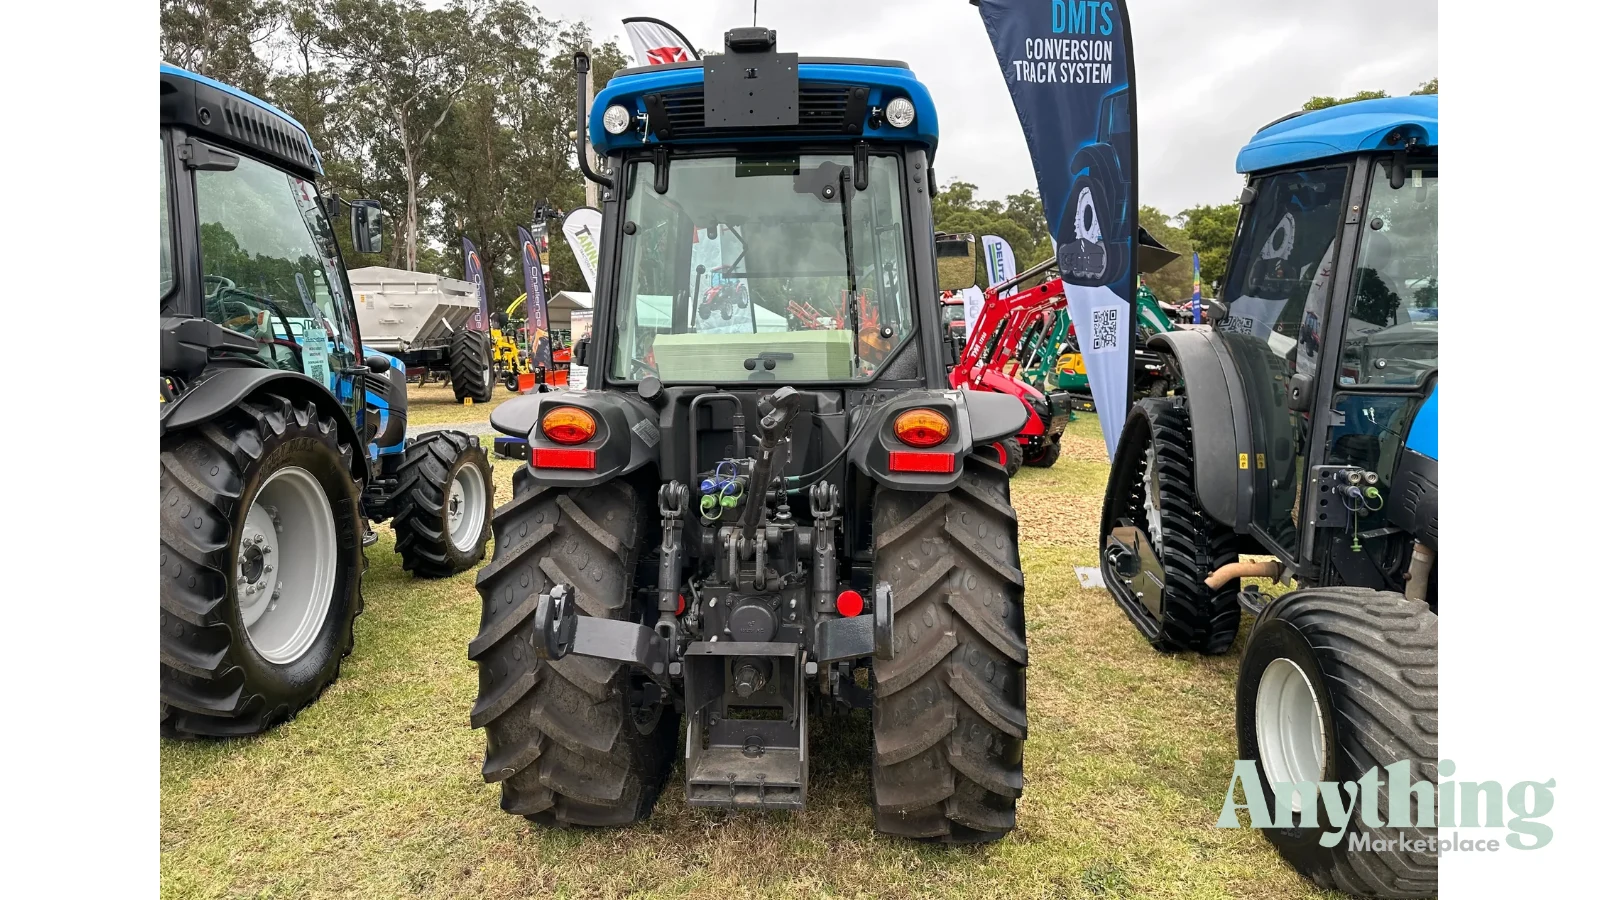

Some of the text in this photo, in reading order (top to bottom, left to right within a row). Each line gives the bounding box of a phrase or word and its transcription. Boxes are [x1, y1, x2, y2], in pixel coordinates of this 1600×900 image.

[1052, 0, 1113, 36] DMTS
[1025, 37, 1112, 61] CONVERSION
[1013, 60, 1112, 84] TRACK SYSTEM
[994, 242, 1005, 282] DEUTZ
